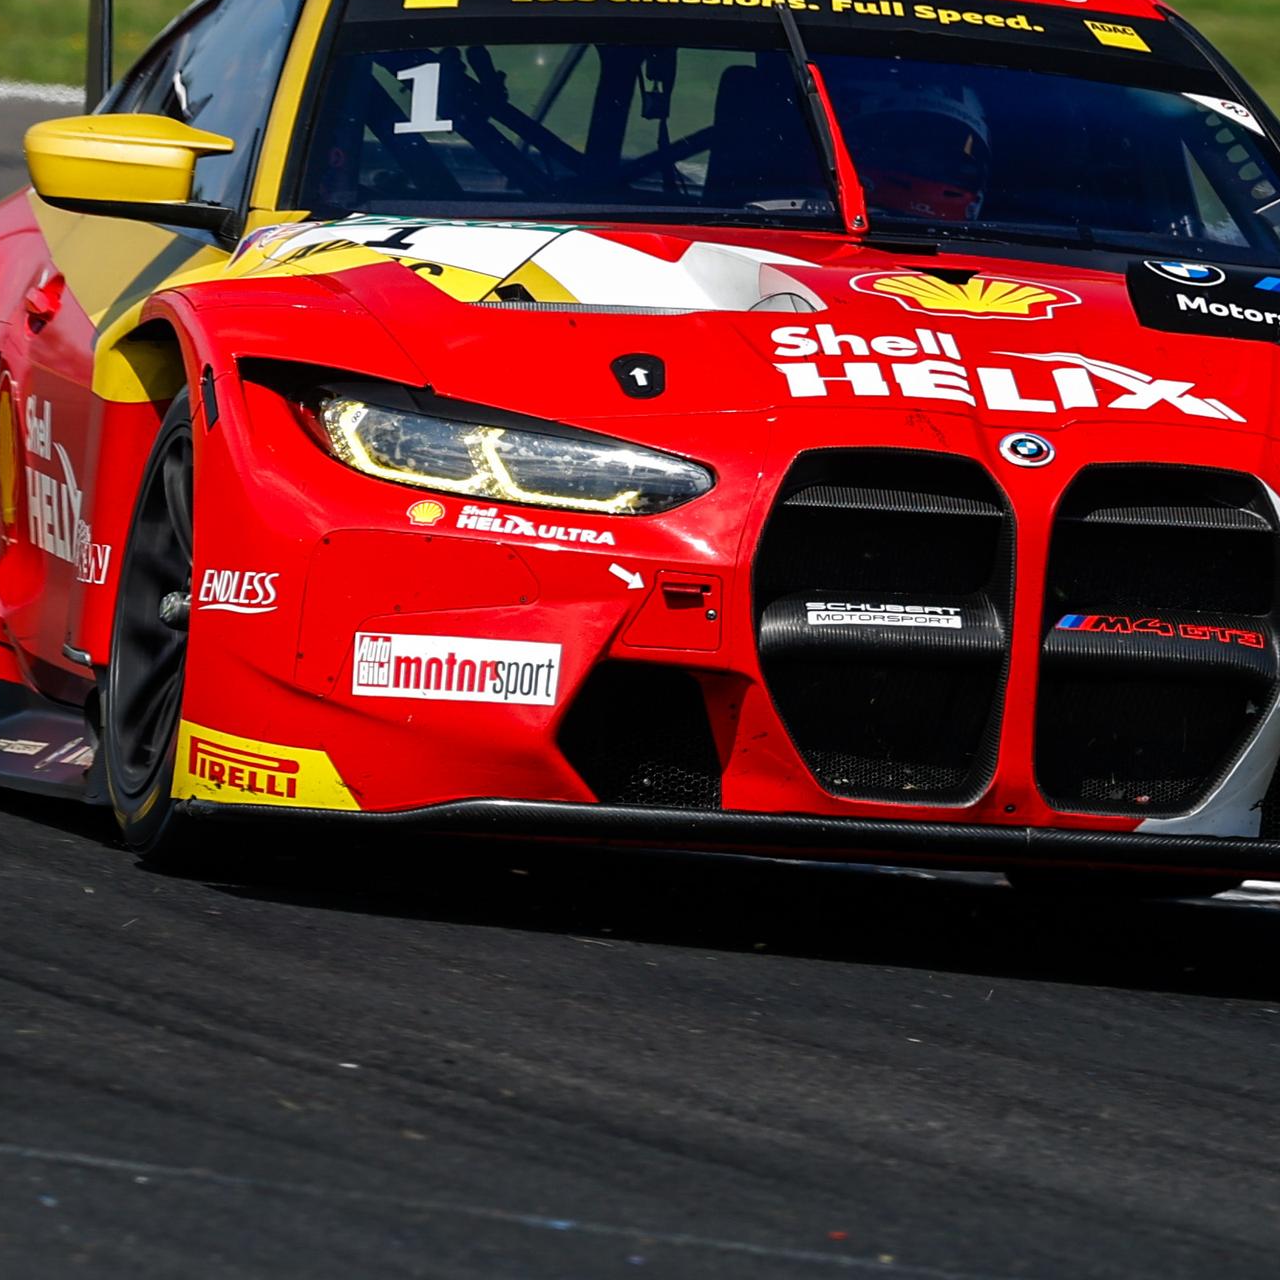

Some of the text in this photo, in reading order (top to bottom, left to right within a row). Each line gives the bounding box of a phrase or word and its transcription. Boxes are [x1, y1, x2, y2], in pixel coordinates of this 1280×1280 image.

[914, 4, 1045, 33] Speed.
[1090, 22, 1135, 37] ADAC
[393, 63, 454, 133] 1
[363, 225, 430, 250] 1
[771, 323, 962, 361] Shell
[776, 350, 1248, 423] HELIX
[25, 395, 52, 461] Shell
[25, 442, 83, 568] HELIX
[462, 505, 498, 518] Shell
[198, 568, 280, 605] ENDLESS
[805, 601, 961, 616] SCHUBERT
[816, 613, 954, 626] MOTORSPORT
[359, 637, 392, 660] Auto
[1180, 624, 1265, 648] GT3
[357, 662, 391, 687] Bild
[392, 651, 555, 699] motorsport
[188, 735, 300, 799] PIRELLI
